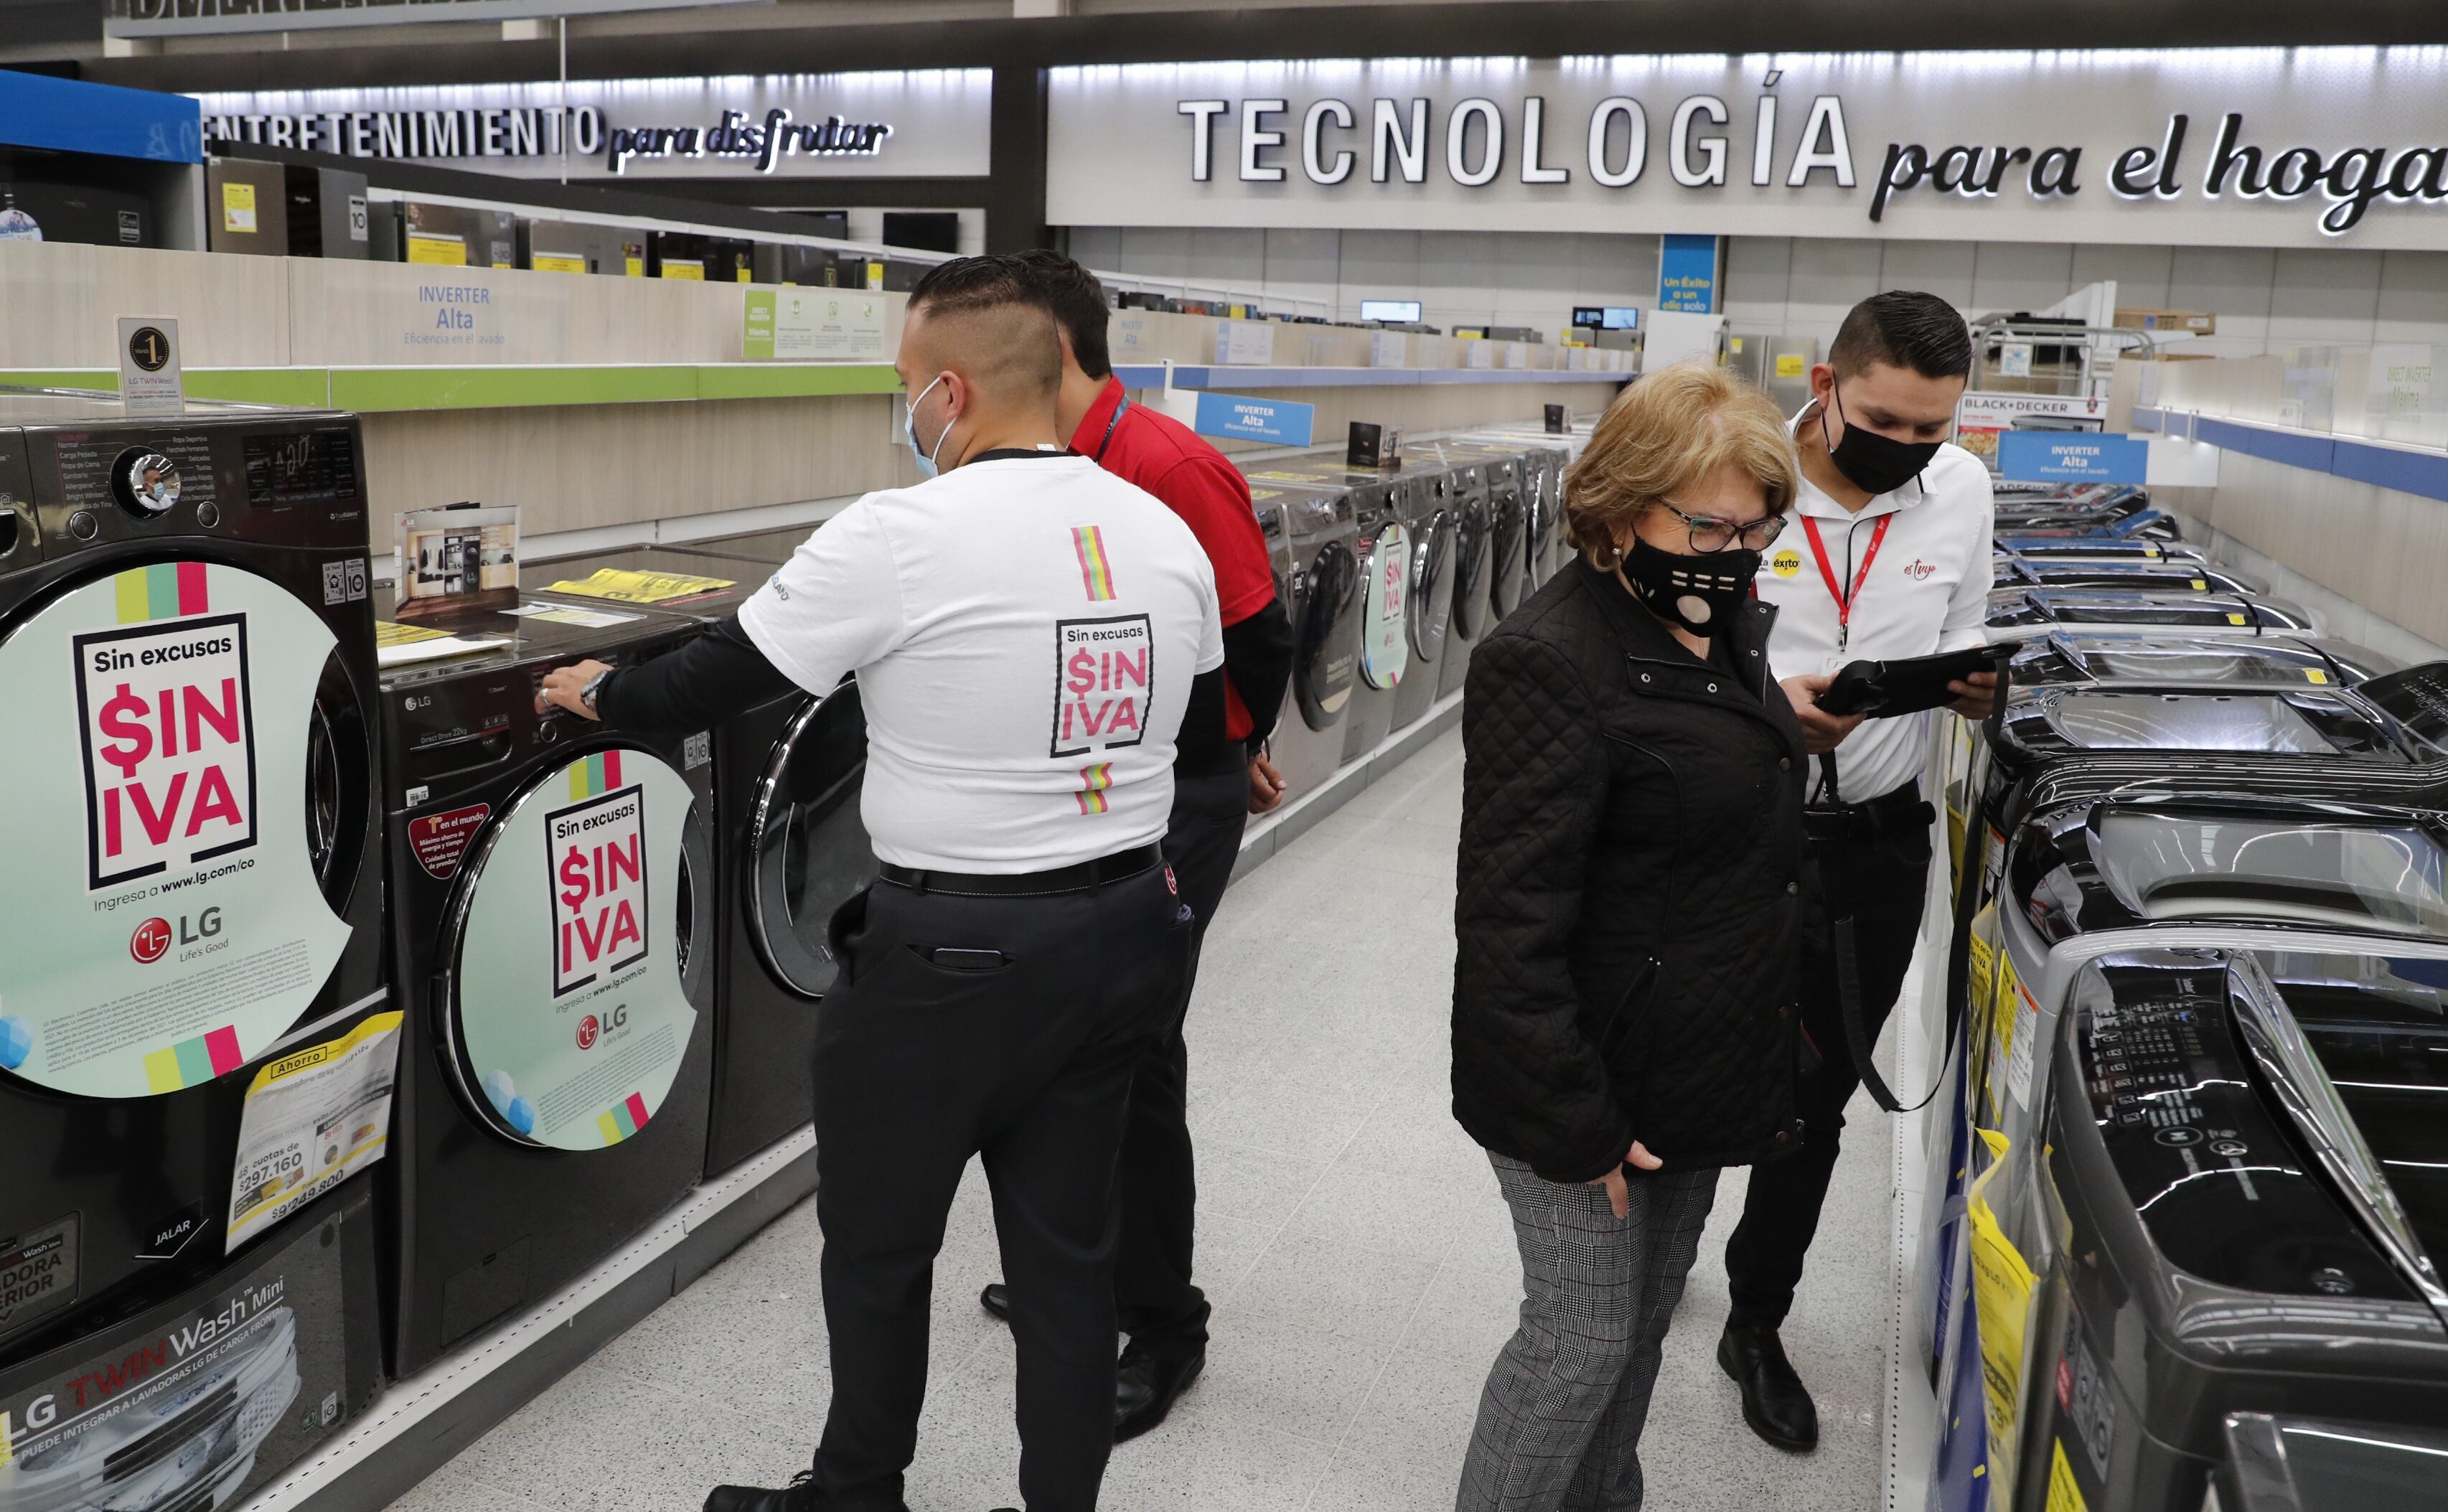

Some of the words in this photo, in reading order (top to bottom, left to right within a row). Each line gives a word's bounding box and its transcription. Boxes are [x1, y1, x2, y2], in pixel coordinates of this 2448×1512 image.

[202, 105, 600, 157] ENTRETENIMIENTO
[609, 127, 703, 174] para
[706, 108, 892, 174] disfrutar
[1177, 70, 1857, 187] TECNOLOGÍA
[1869, 143, 2083, 222] para
[2110, 113, 2189, 199] el
[2203, 112, 2448, 236] hoga
[419, 286, 489, 304] INVERTER
[436, 308, 473, 329] Alta
[405, 333, 449, 344] Eficiencia
[451, 336, 463, 344] en
[466, 334, 474, 344] el
[479, 334, 505, 344] avado
[1234, 404, 1275, 416] INVERTER
[1242, 415, 1264, 427] Alta
[1964, 398, 2068, 414] BLACK+DECKER
[2051, 446, 2100, 456] INVERTER
[2061, 456, 2088, 467] Alta
[1773, 555, 1800, 570] éxito
[1067, 629, 1089, 642] Sin
[1092, 625, 1144, 642] excusas
[94, 649, 135, 673] Sin
[141, 637, 233, 667] excusas
[1066, 647, 1146, 700] $IN
[418, 696, 431, 708] LG
[1061, 697, 1139, 741] IVA
[98, 677, 241, 779] $IN
[103, 764, 243, 859] IVA
[451, 817, 459, 826] el
[459, 812, 484, 825] mundo
[557, 820, 580, 840] Sin
[583, 802, 636, 832] excusas
[94, 889, 146, 912] Ingresa
[149, 886, 159, 897] a
[161, 858, 255, 893] www.lg.com/co
[560, 832, 641, 916] $IN
[179, 906, 222, 946] LG
[562, 899, 642, 975] IVA
[180, 947, 204, 963] Life's
[206, 938, 230, 954] Good
[555, 995, 585, 1015] Ingresa
[593, 966, 647, 997] www.lg.com/co
[603, 1003, 627, 1035] LG
[277, 1051, 321, 1074] Ahorro
[239, 1151, 302, 1193] $297.160
[253, 1148, 285, 1169] cuotas
[287, 1142, 300, 1153] de
[155, 1219, 192, 1246] JALAR
[0, 1252, 62, 1290] DORA
[1, 1394, 57, 1442] LG
[66, 1337, 167, 1409] TWIN
[252, 1274, 284, 1311] Mini
[22, 1434, 62, 1460] PUEDE
[63, 1404, 121, 1441] INTEGRAR
[121, 1400, 131, 1412] A
[131, 1366, 191, 1404] LAVADORAS
[192, 1358, 205, 1372] LG
[205, 1348, 219, 1363] DE
[220, 1330, 250, 1354] CARGA
[250, 1305, 285, 1335] FRONTAL
